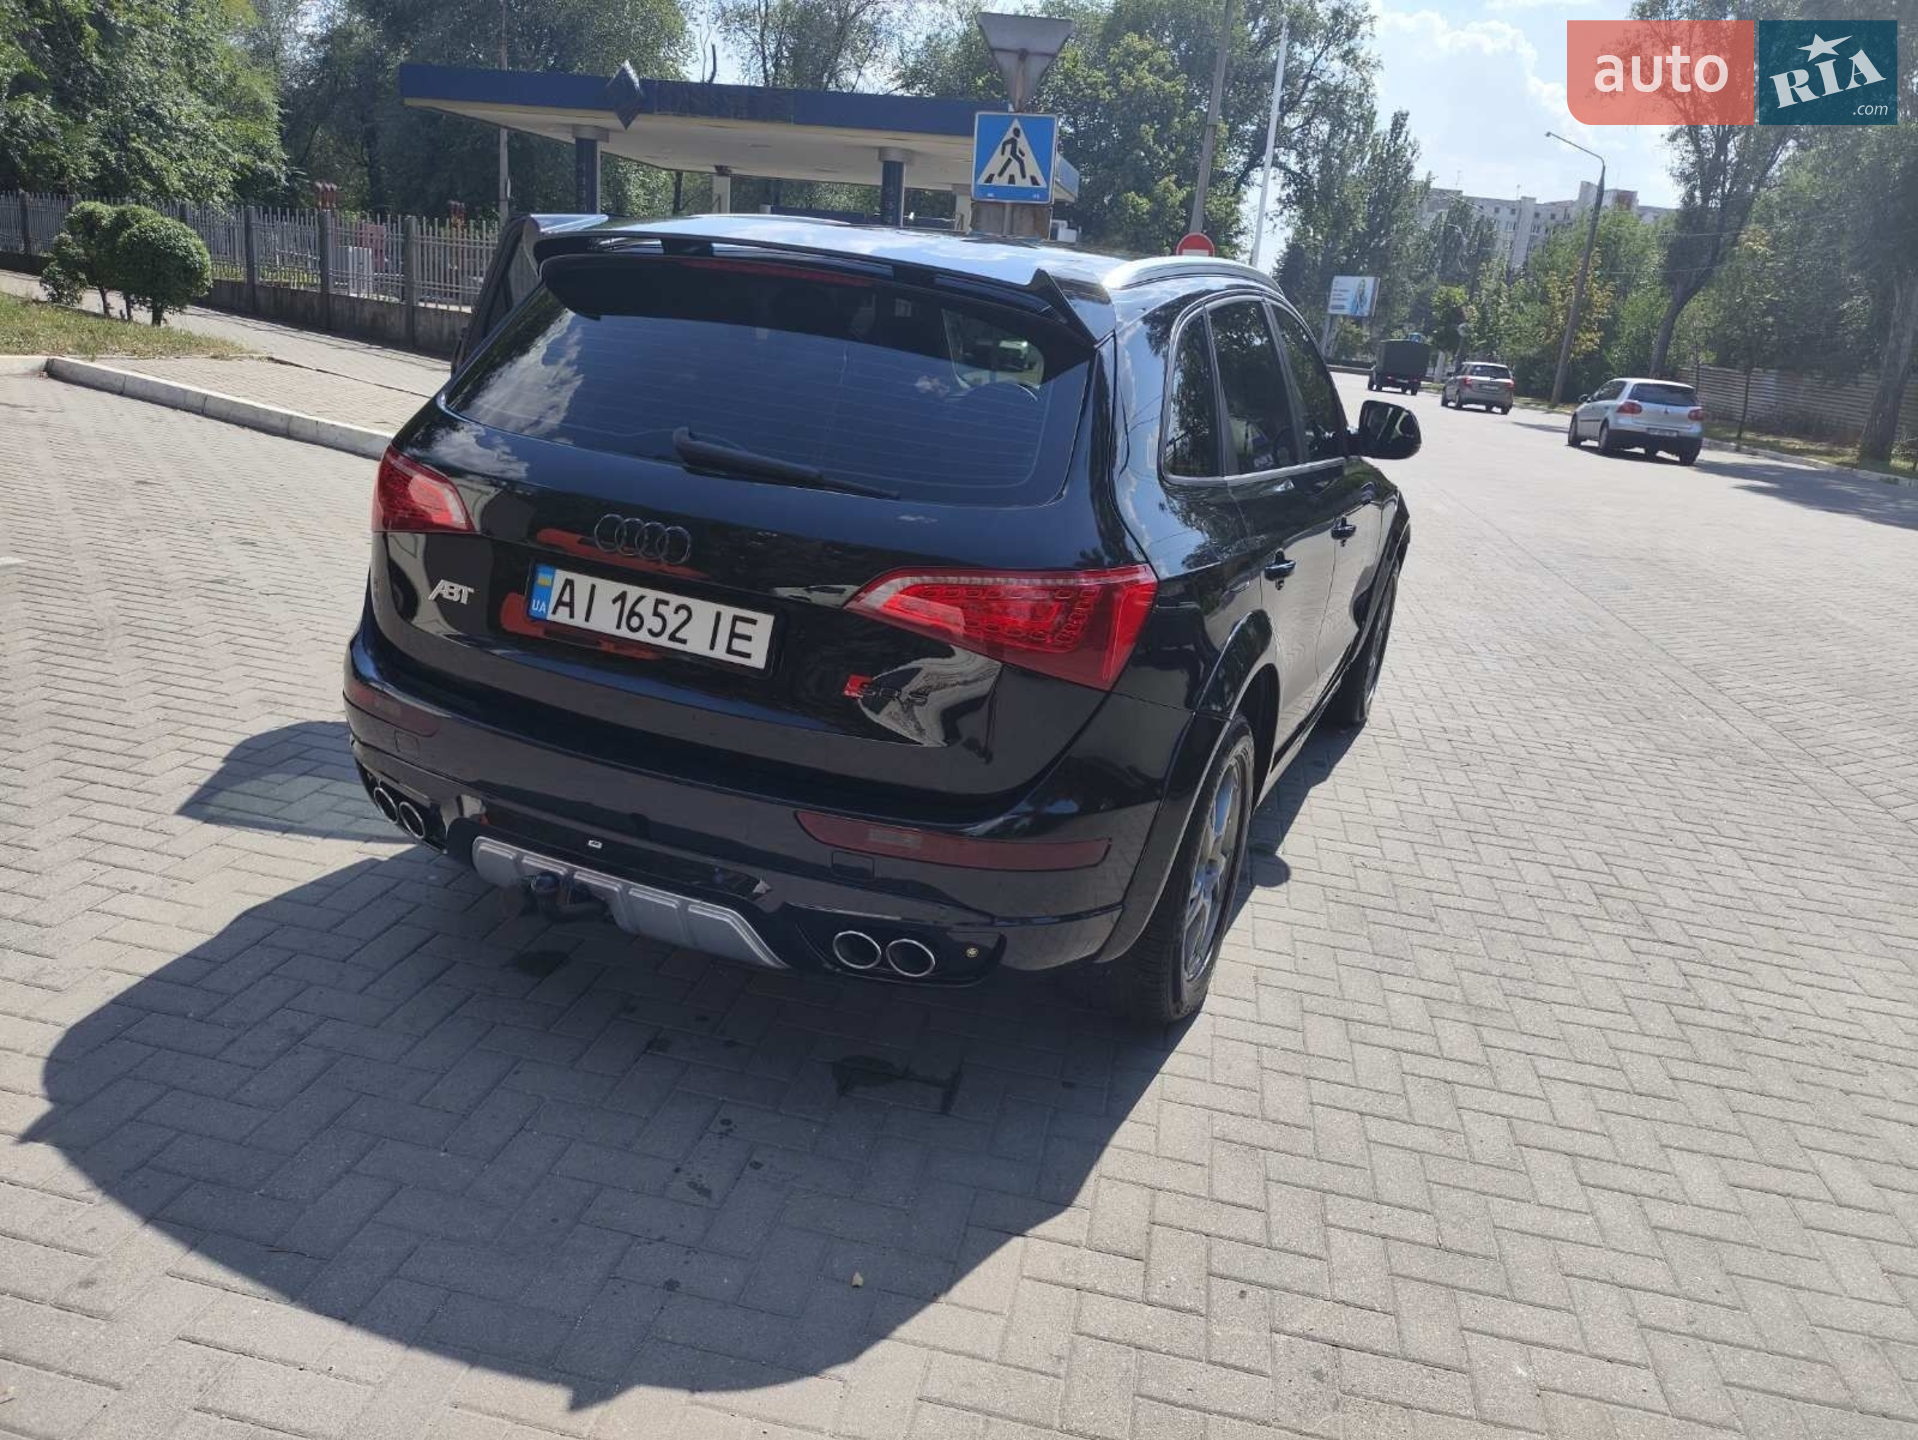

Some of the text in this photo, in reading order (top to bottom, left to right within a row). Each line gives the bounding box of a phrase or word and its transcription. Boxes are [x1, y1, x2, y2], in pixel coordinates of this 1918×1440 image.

[428, 579, 475, 605] ABT
[531, 598, 547, 614] UA
[551, 578, 758, 659] AI 1652 IE
